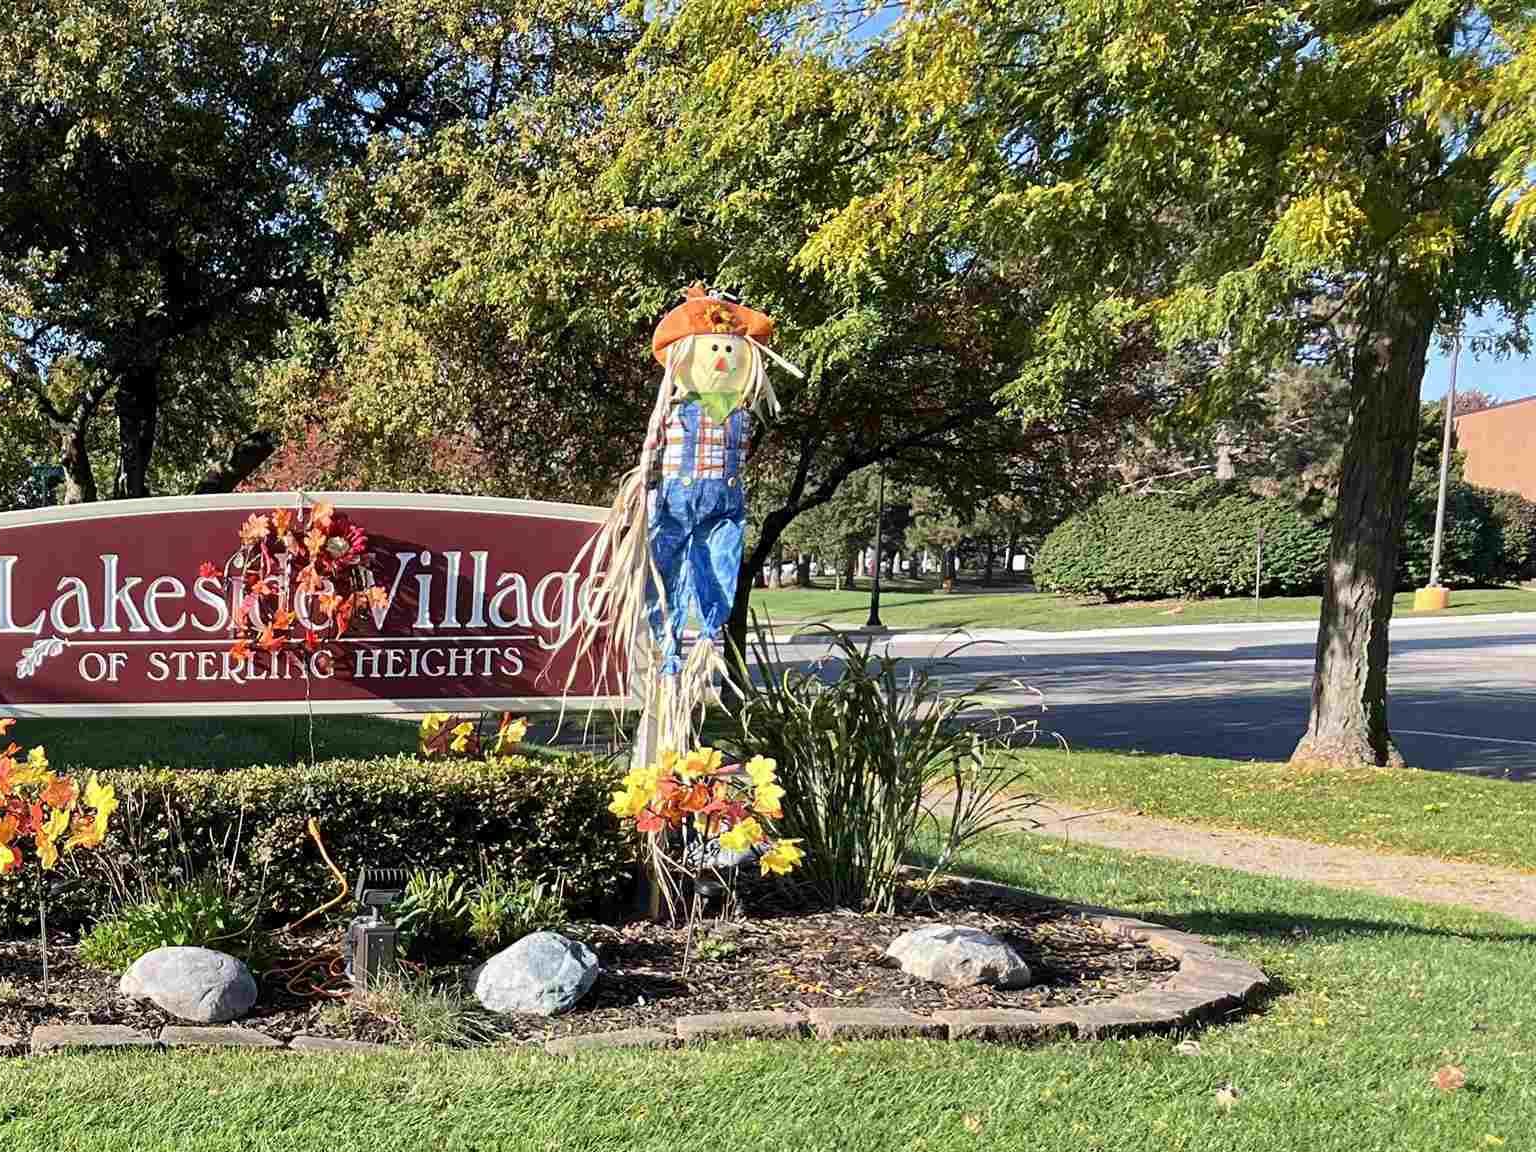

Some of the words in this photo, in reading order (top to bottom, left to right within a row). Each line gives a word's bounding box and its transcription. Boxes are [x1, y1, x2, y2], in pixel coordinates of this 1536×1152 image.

[353, 550, 616, 650] Village
[78, 652, 128, 682] OF
[147, 650, 335, 684] STERLING
[353, 647, 524, 678] HEIGHTS
